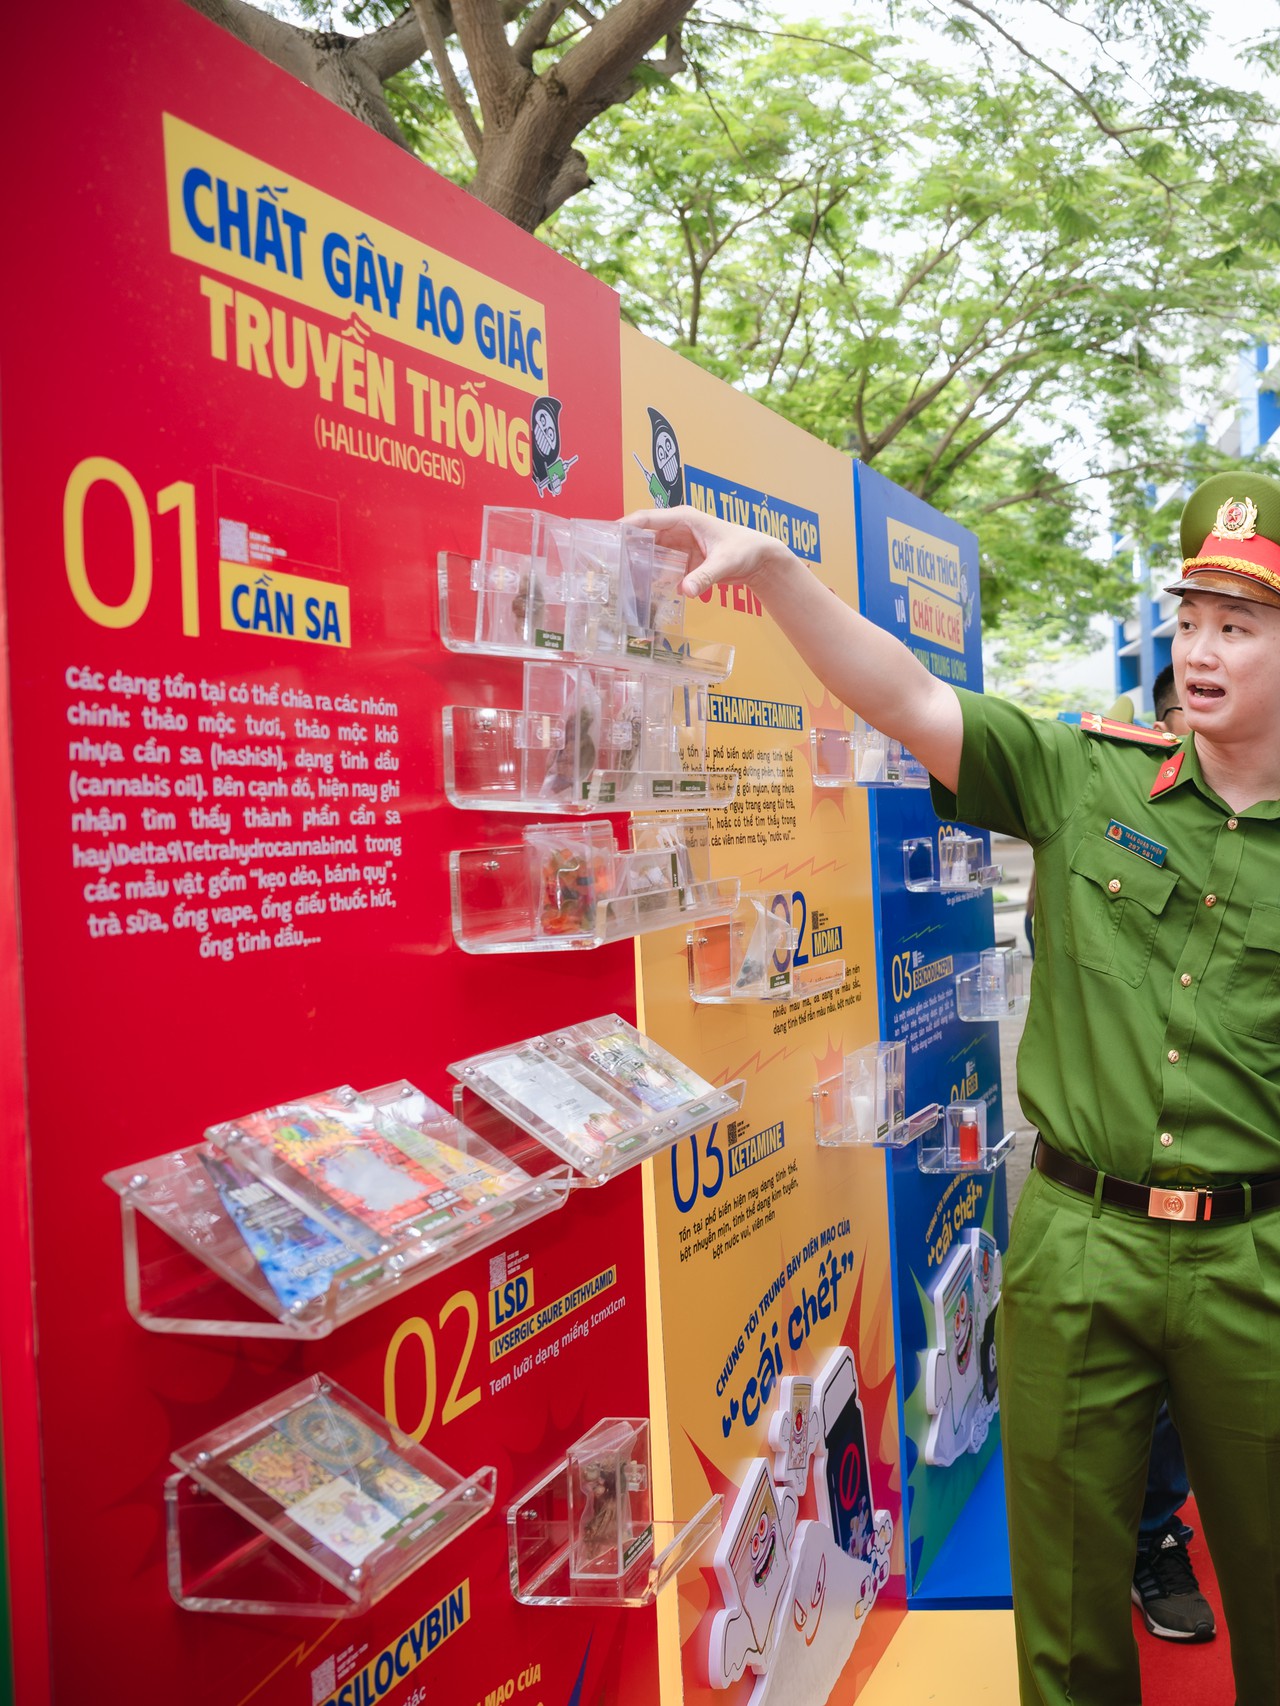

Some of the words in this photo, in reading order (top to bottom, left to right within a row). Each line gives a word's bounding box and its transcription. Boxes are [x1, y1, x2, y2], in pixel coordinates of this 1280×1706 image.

[182, 168, 306, 280] CHẤT
[322, 232, 403, 321] GÂY
[416, 259, 464, 346] ẢO
[474, 302, 544, 381] GIÁC
[200, 275, 395, 426] TRUYỀN
[406, 369, 530, 476] THỐNG
[314, 414, 466, 488] (HALLUCINOGENS)
[62, 456, 200, 636] 01
[753, 494, 789, 546] TỔNG
[792, 518, 817, 556] HỢP
[892, 536, 914, 574] CHẤT
[916, 545, 935, 580] KÍCH
[937, 555, 958, 588] THÍCH
[231, 574, 294, 635] CẦN
[305, 597, 341, 643] SA
[895, 596, 906, 623] VÀ
[912, 597, 933, 633] CHẤT
[65, 666, 104, 690] Các
[108, 670, 160, 703] dạng
[163, 672, 196, 700] tồn
[200, 679, 226, 706] tại
[229, 682, 249, 703] có
[251, 681, 279, 707] thể
[281, 689, 313, 710] chia
[316, 694, 332, 711] ra
[335, 694, 358, 714] các
[361, 697, 397, 717] nhóm
[701, 694, 801, 730] METHAMPHETAMINE
[67, 701, 130, 728] chính:
[142, 706, 188, 731] thảo
[198, 712, 235, 738] mộc
[245, 715, 286, 740] tươi,
[295, 720, 330, 740] thảo
[338, 724, 367, 746] mộc
[375, 724, 399, 743] khô
[69, 738, 124, 767] nhựa
[134, 737, 170, 764] cần
[180, 746, 202, 765] sa
[211, 742, 287, 772] (hashish),
[295, 751, 333, 773] dạng
[375, 749, 399, 771] dầu
[69, 770, 171, 803] (cannabis
[175, 773, 207, 802] oil).
[213, 776, 245, 797] Bên
[248, 777, 287, 801] cạnh
[291, 777, 315, 800] đó,
[318, 778, 349, 801] hiện
[352, 784, 377, 803] nay
[381, 779, 400, 803] ghi
[72, 808, 126, 837] nhận
[142, 807, 176, 831] tìm
[190, 803, 230, 835] thấy
[243, 806, 291, 828] thành
[303, 803, 339, 831] phần
[350, 803, 375, 825] cần
[385, 810, 401, 825] sa
[365, 834, 401, 856] trong
[84, 877, 121, 903] các
[126, 869, 169, 900] mẫu
[173, 873, 204, 900] vật
[209, 868, 246, 899] gồm
[289, 864, 321, 887] dẻo,
[325, 863, 360, 884] bánh
[88, 914, 122, 939] trà
[126, 908, 169, 934] sữa,
[173, 902, 208, 933] ống
[212, 902, 257, 930] vape,
[261, 896, 292, 923] ống
[295, 891, 326, 916] điếu
[329, 887, 367, 912] thuốc
[370, 888, 396, 908] hút,
[771, 891, 809, 972] 02
[199, 931, 234, 961] ống
[814, 928, 841, 956] MDMA
[892, 951, 912, 1003] 03
[731, 1123, 783, 1175] KETAMINE
[718, 1201, 732, 1219] biến
[734, 1194, 746, 1208] hiện
[748, 1187, 759, 1202] nay
[760, 1177, 775, 1193] dạng
[491, 1320, 535, 1361] (LYSERGIC
[537, 1298, 563, 1330] SAURE
[564, 1268, 615, 1313] DIETHYLAMID)
[494, 1275, 528, 1326] LSD
[716, 1335, 745, 1397] CHÚNG
[743, 1309, 759, 1341] TÔI
[759, 1271, 786, 1316] TRUNG
[802, 1235, 819, 1262] DIỆN
[837, 1216, 850, 1238] CỦA
[384, 1290, 481, 1449] 02
[489, 1372, 511, 1396] Tem
[513, 1355, 533, 1379] lưỡi
[535, 1336, 559, 1365] dạng
[562, 1317, 589, 1348] miếng
[590, 1295, 626, 1329] 1cmx1cm
[322, 1585, 464, 1706] SILOCYBIN
[517, 1663, 541, 1692] CỦA
